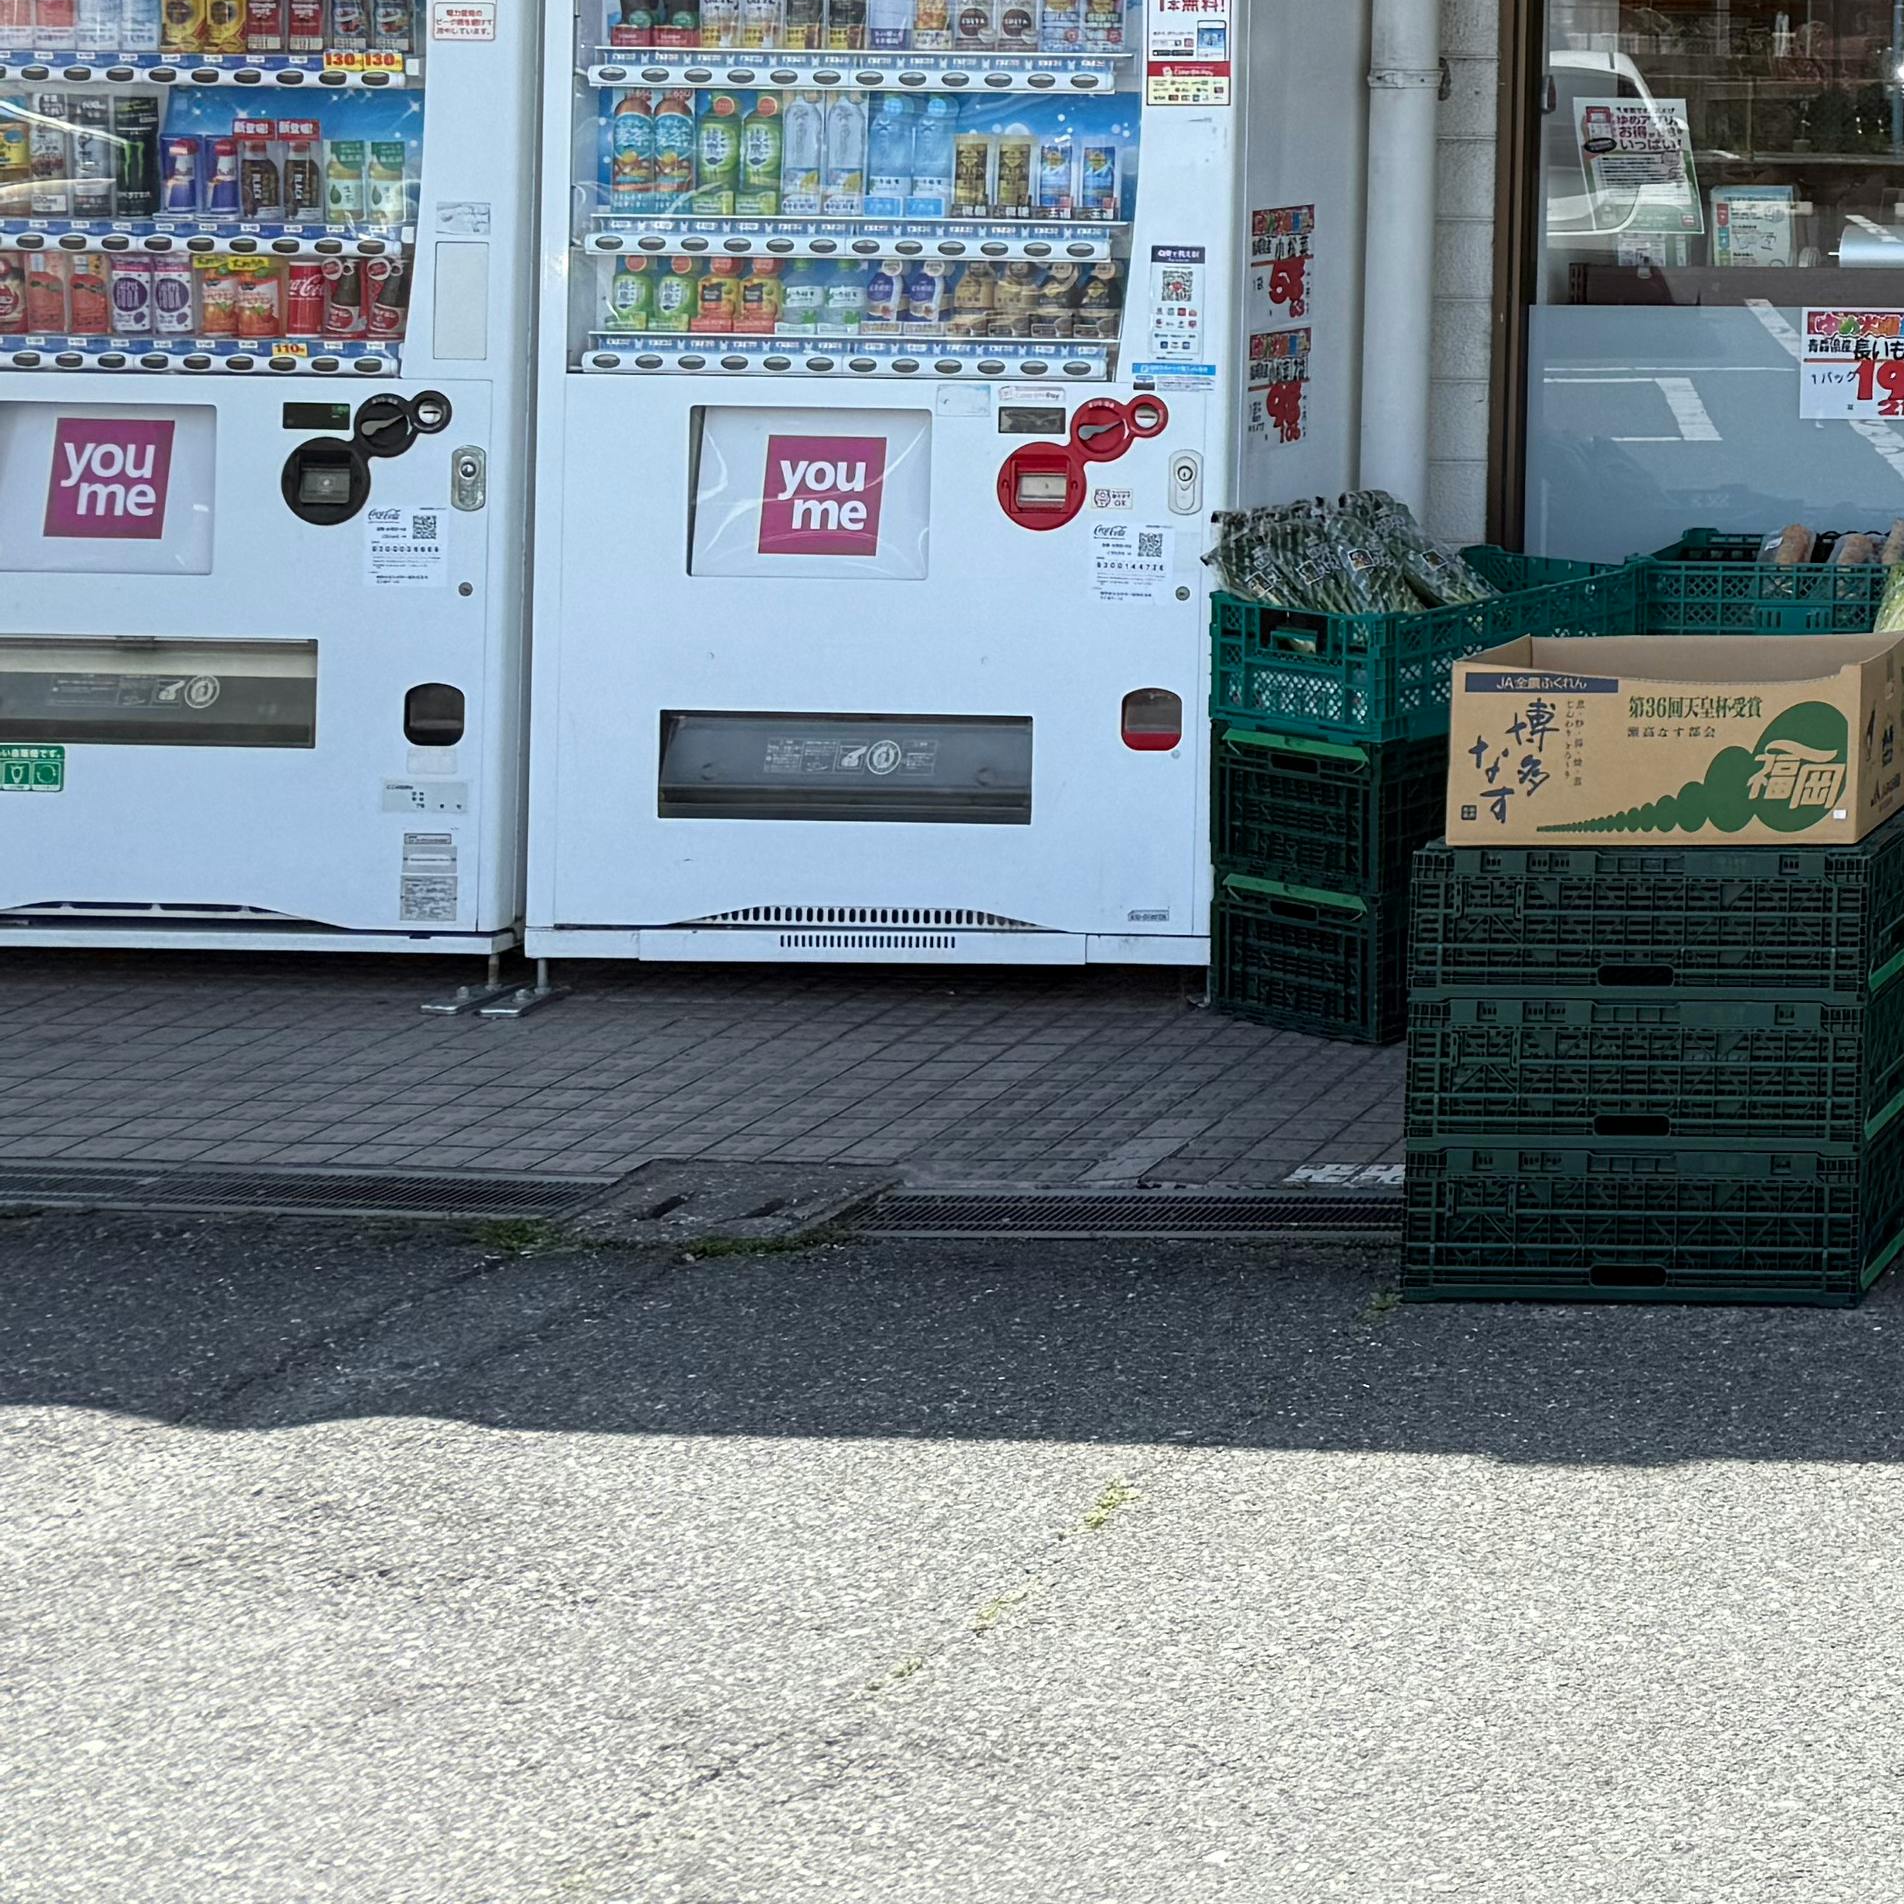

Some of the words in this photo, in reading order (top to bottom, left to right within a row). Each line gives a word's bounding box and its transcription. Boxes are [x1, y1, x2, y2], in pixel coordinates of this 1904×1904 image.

[61, 441, 155, 487] you
[778, 458, 865, 501] you
[75, 483, 157, 517] me
[791, 497, 867, 531] me
[1628, 695, 1763, 720] 第36回天皇杯受賞
[1747, 739, 1847, 812] 福岡
